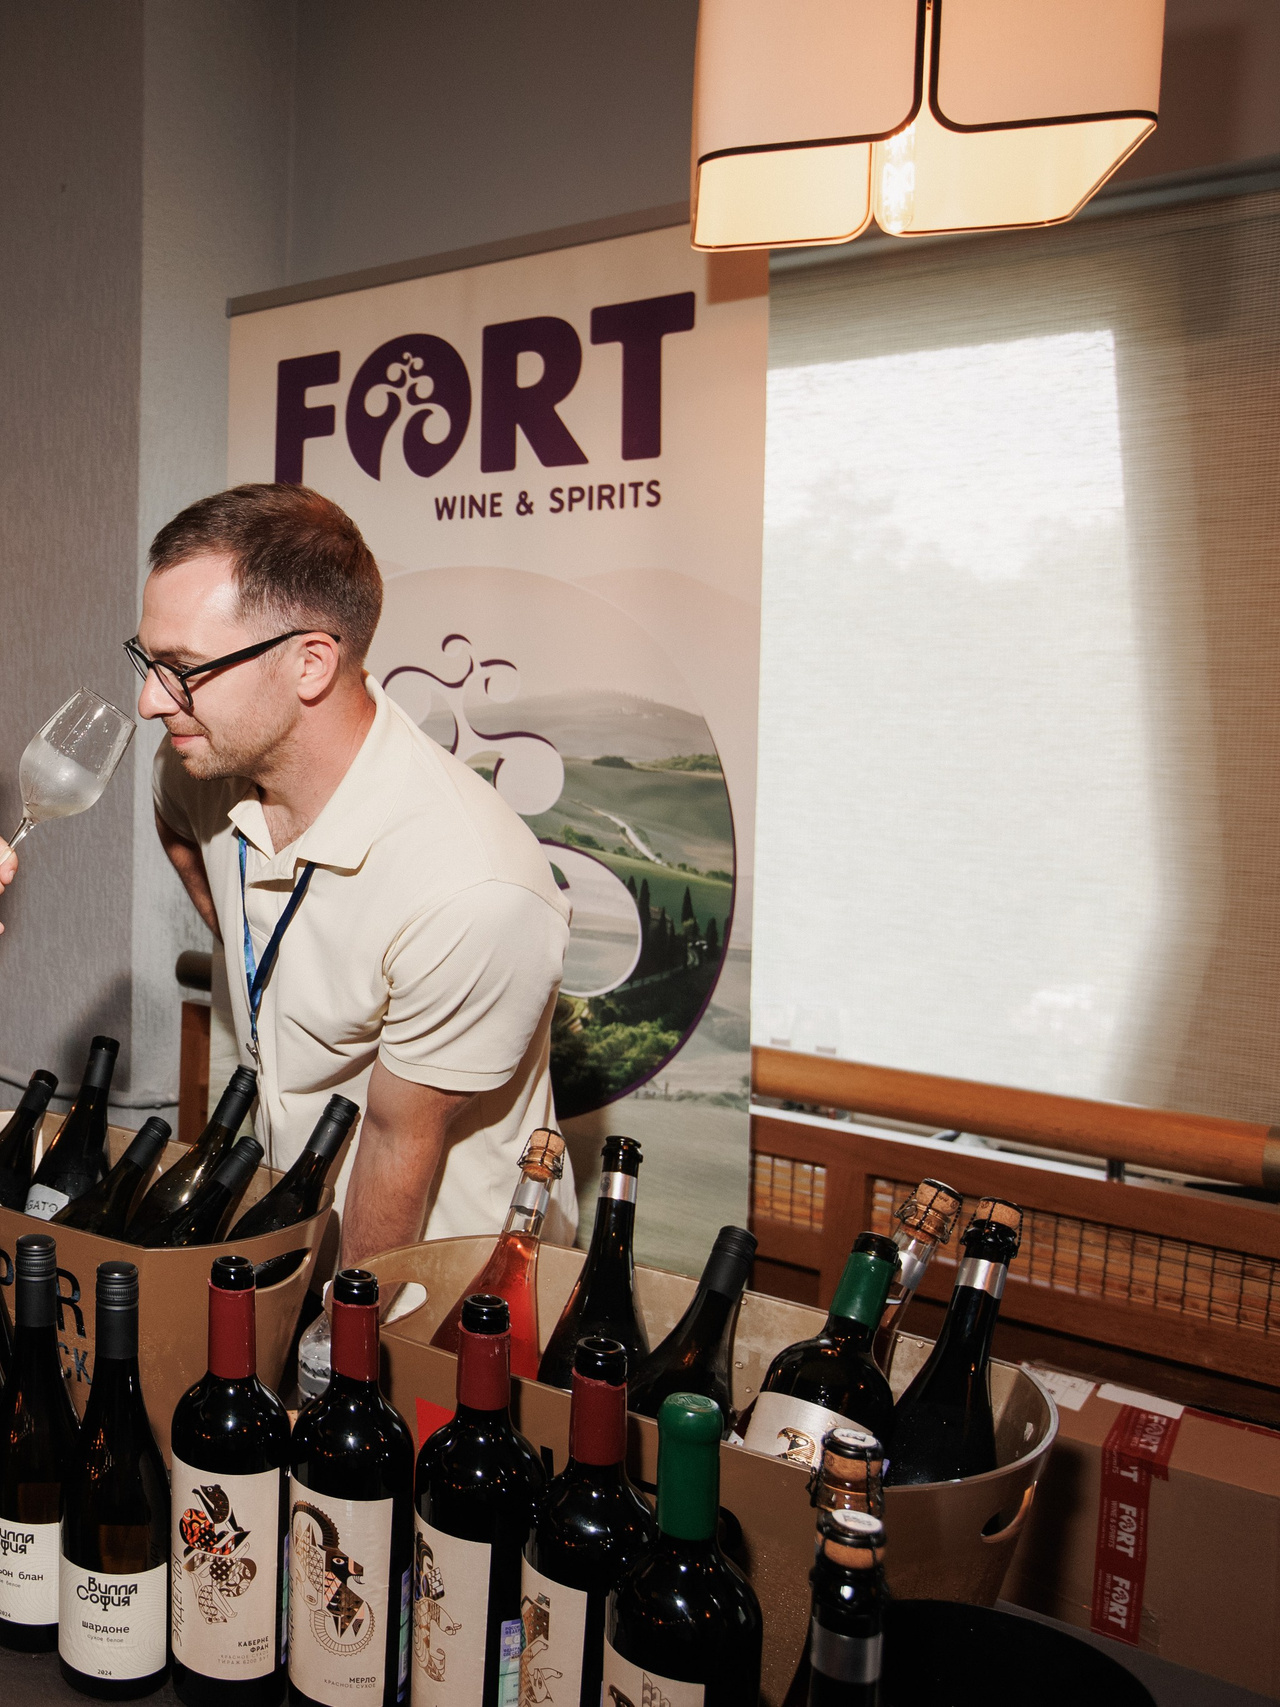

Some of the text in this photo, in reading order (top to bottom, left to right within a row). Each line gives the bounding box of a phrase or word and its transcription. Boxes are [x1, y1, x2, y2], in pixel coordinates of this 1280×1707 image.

[275, 291, 696, 485] FORT
[434, 480, 662, 521] WINE & SPIRITS
[25, 1199, 59, 1213] GATO
[1138, 1414, 1167, 1454] FORT
[1110, 1500, 1118, 1518] WINE
[1107, 1524, 1117, 1549] SPIRITS
[1115, 1502, 1138, 1558] FORT
[19, 1571, 45, 1581] блан
[88, 1576, 138, 1596] Вилла
[76, 1584, 131, 1612] София
[1107, 1574, 1132, 1629] FORT
[82, 1620, 130, 1634] шардоне
[237, 1635, 269, 1648] КАБЕРНЕ
[249, 1643, 269, 1654] ФРАН
[97, 1669, 113, 1677] 2024
[349, 1676, 377, 1684] МЕРЛО
[323, 1679, 353, 1689] КРАСНОЕ
